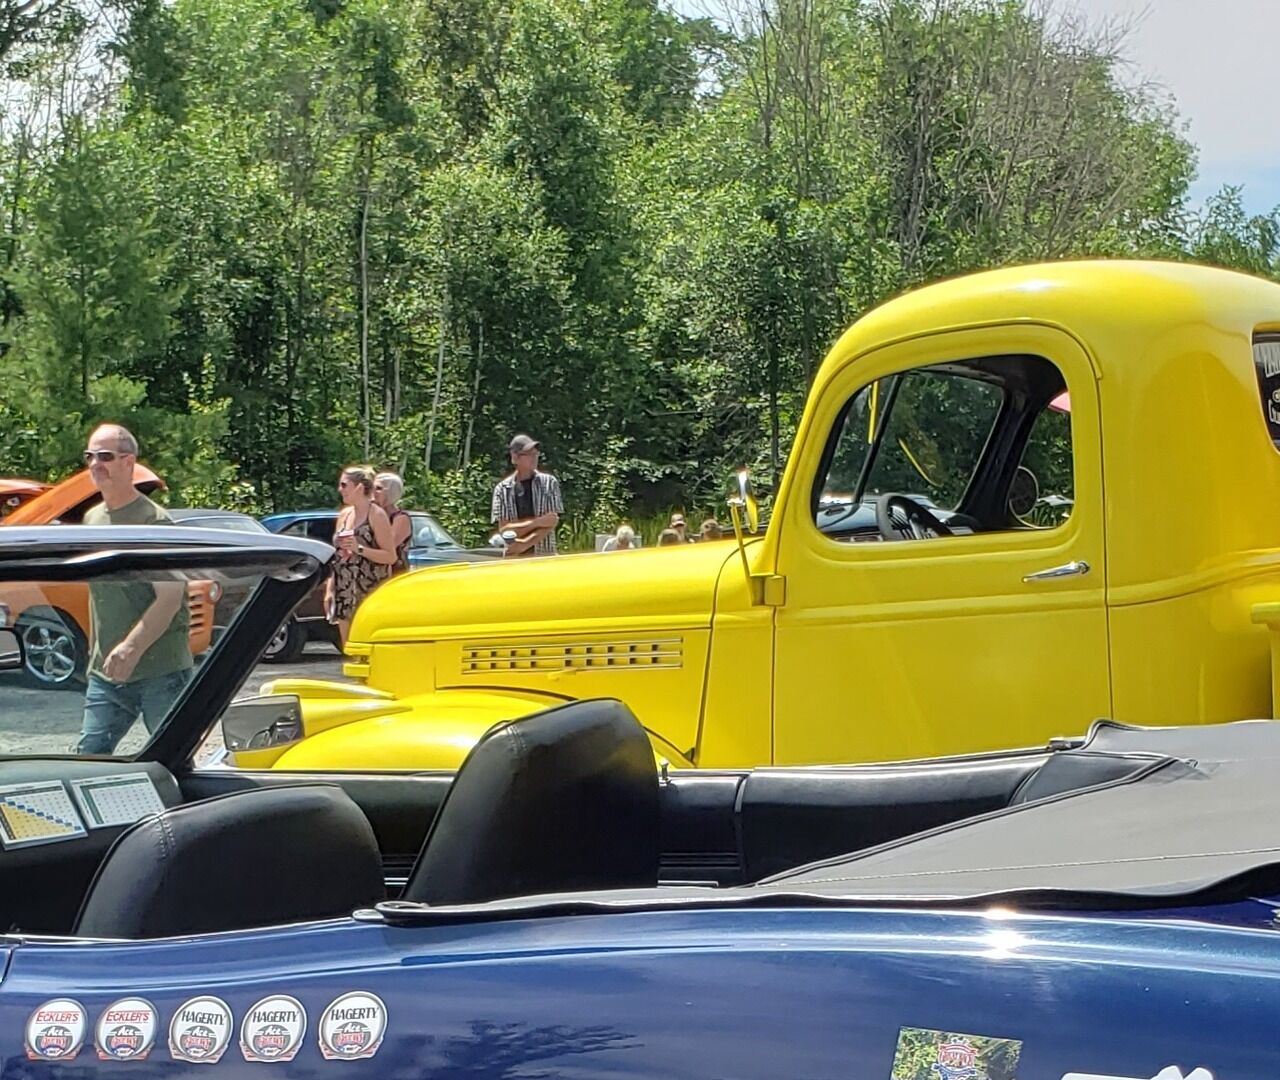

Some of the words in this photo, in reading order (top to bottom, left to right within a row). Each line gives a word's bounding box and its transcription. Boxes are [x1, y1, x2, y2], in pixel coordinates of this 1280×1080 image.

[37, 1011, 80, 1022] ECKLER'S
[107, 1010, 150, 1022] ECKLER'S
[181, 1010, 225, 1026] HAGERTY
[252, 1010, 298, 1023] HAGERTY
[331, 1007, 377, 1021] HAGERTY
